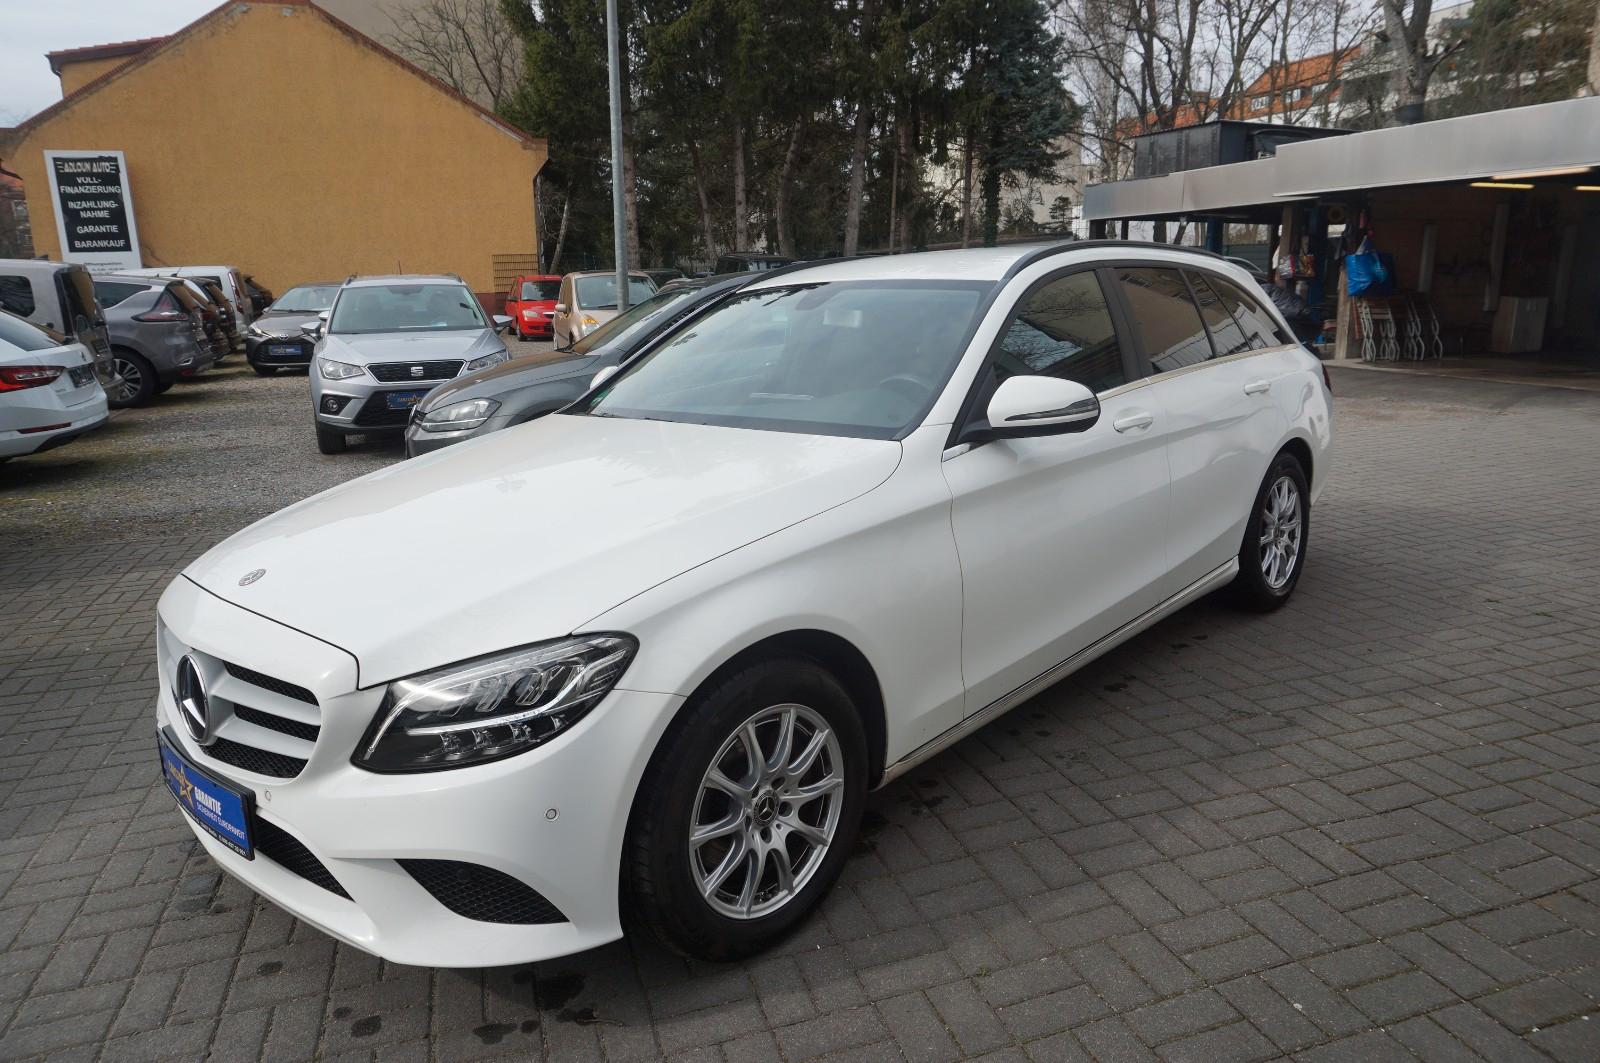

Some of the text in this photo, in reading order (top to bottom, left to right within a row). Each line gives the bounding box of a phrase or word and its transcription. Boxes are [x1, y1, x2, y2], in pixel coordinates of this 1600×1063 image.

[60, 185, 121, 194] FINANZIERUNG
[67, 200, 120, 209] INZAHLUNG-
[80, 210, 111, 218] NAHME
[76, 225, 119, 234] GARANTIE
[74, 239, 126, 248] BARANKAUF
